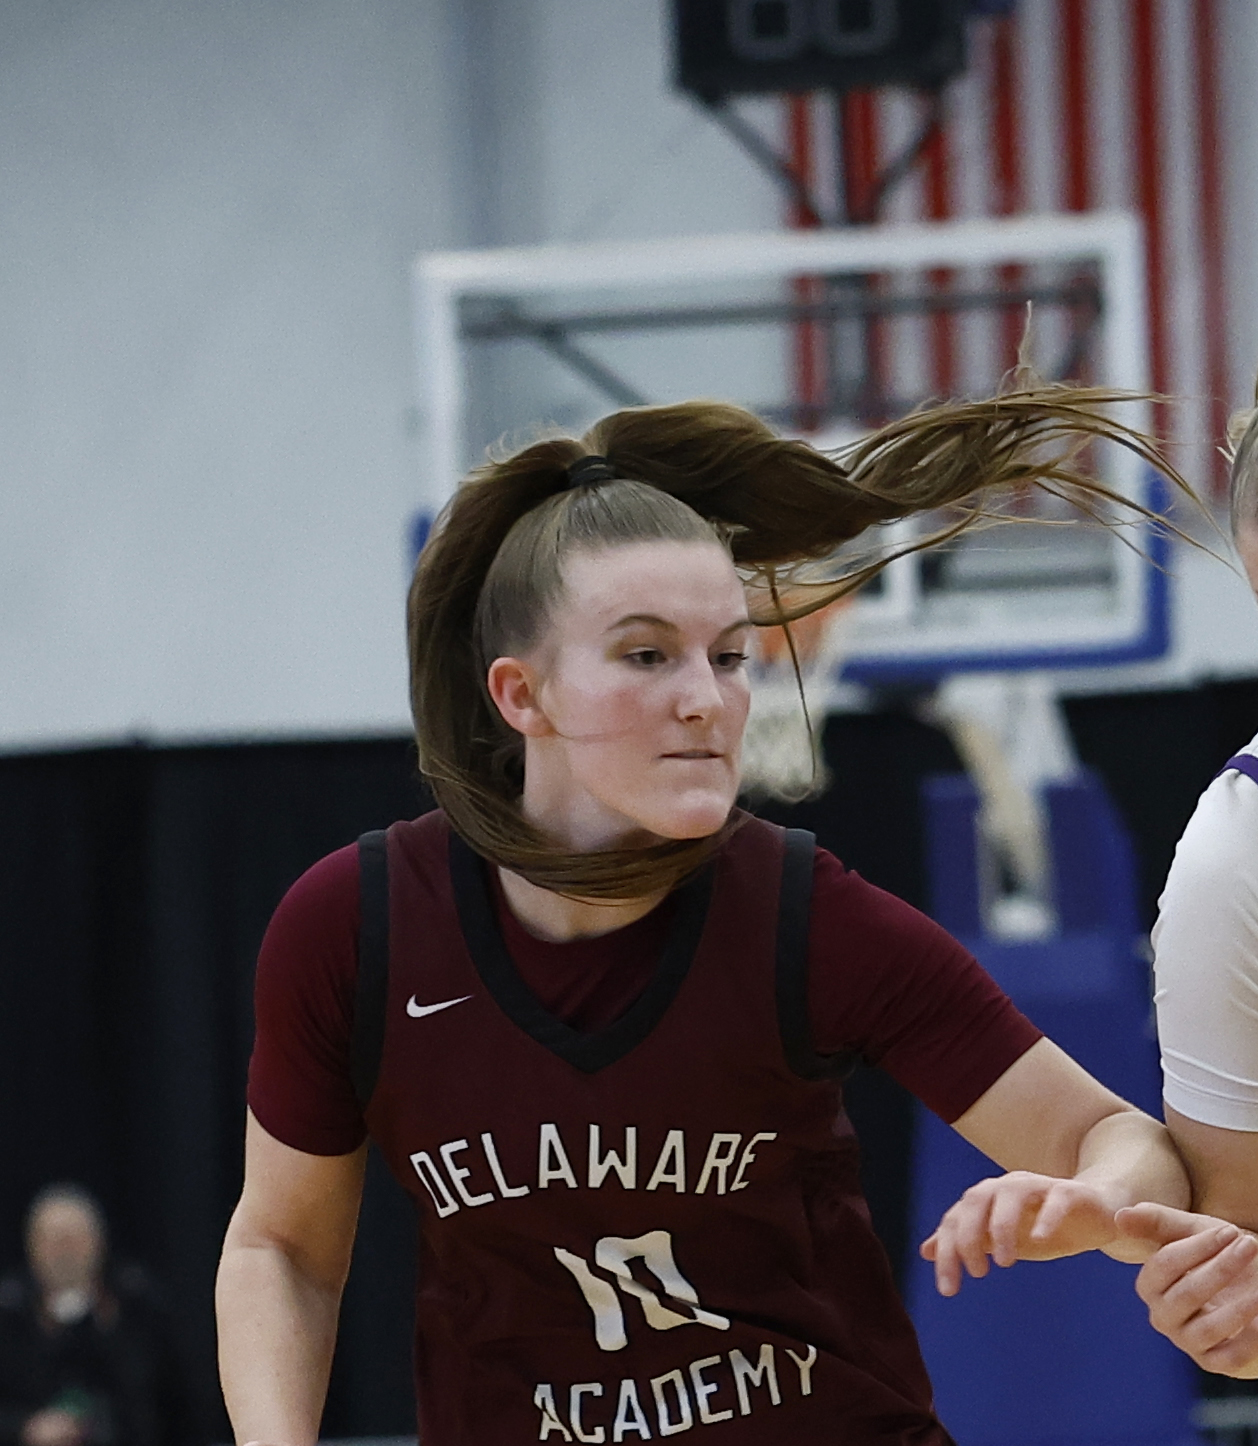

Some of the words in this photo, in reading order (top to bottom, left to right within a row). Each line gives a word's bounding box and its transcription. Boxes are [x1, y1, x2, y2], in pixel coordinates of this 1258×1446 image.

[409, 1123, 777, 1218] DELAWARE
[553, 1230, 730, 1351] 10
[534, 1344, 817, 1443] ACADEMY
